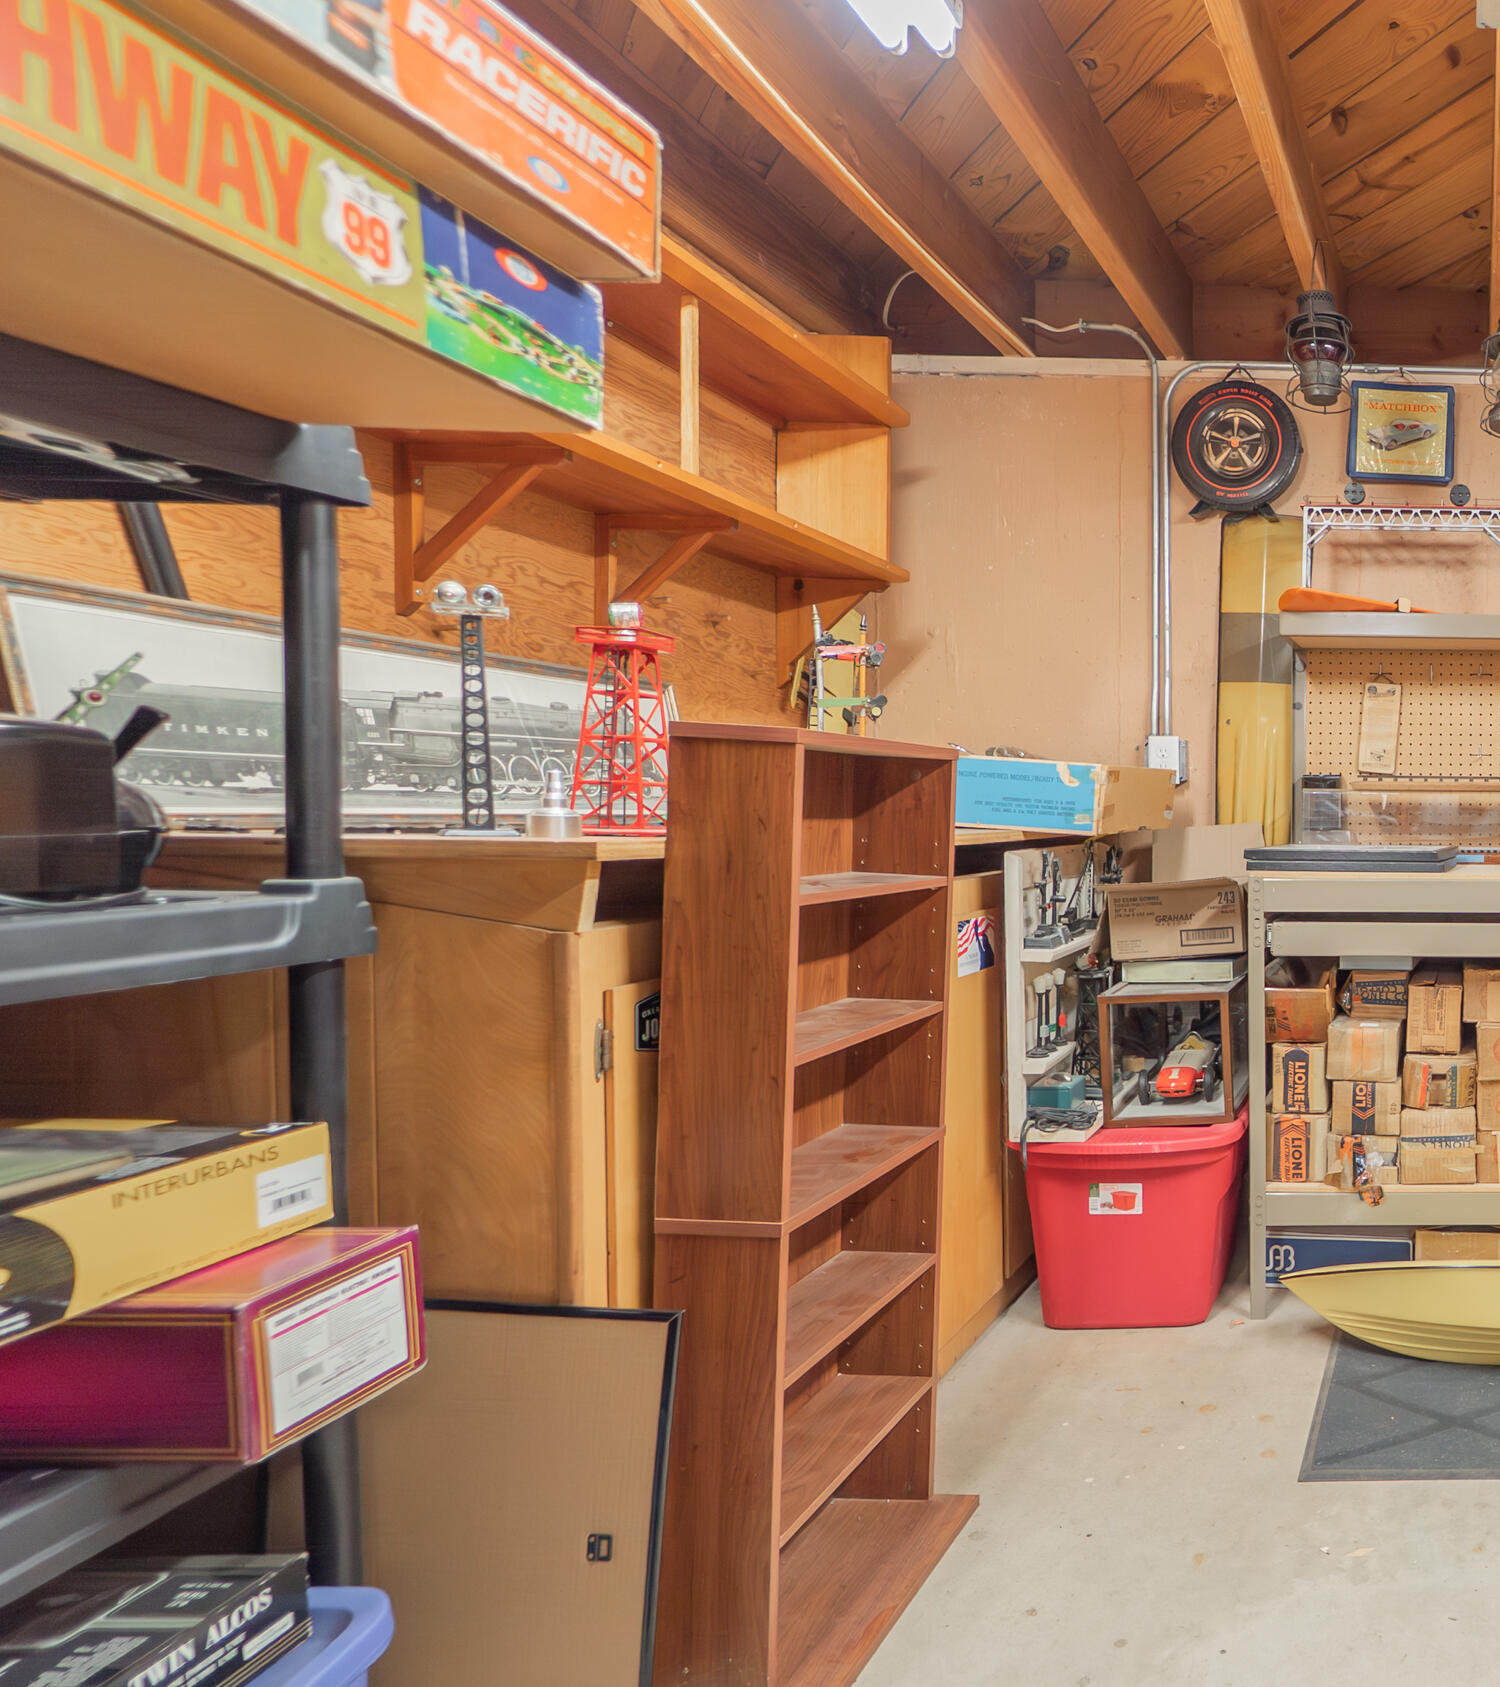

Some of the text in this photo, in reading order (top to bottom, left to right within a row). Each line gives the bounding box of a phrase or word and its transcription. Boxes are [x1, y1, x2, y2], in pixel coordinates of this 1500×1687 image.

[406, 3, 648, 197] RACERIFIC
[343, 201, 392, 268] 99
[163, 722, 269, 737] TIMKEN
[1217, 890, 1236, 905] 243
[1155, 912, 1194, 924] GRAHAM
[1168, 1068, 1180, 1079] 1
[1355, 1081, 1366, 1107] LIO
[111, 1145, 280, 1210] INTERURBANS
[127, 1638, 197, 1687] TWIN
[205, 1587, 273, 1650] ALCOS
